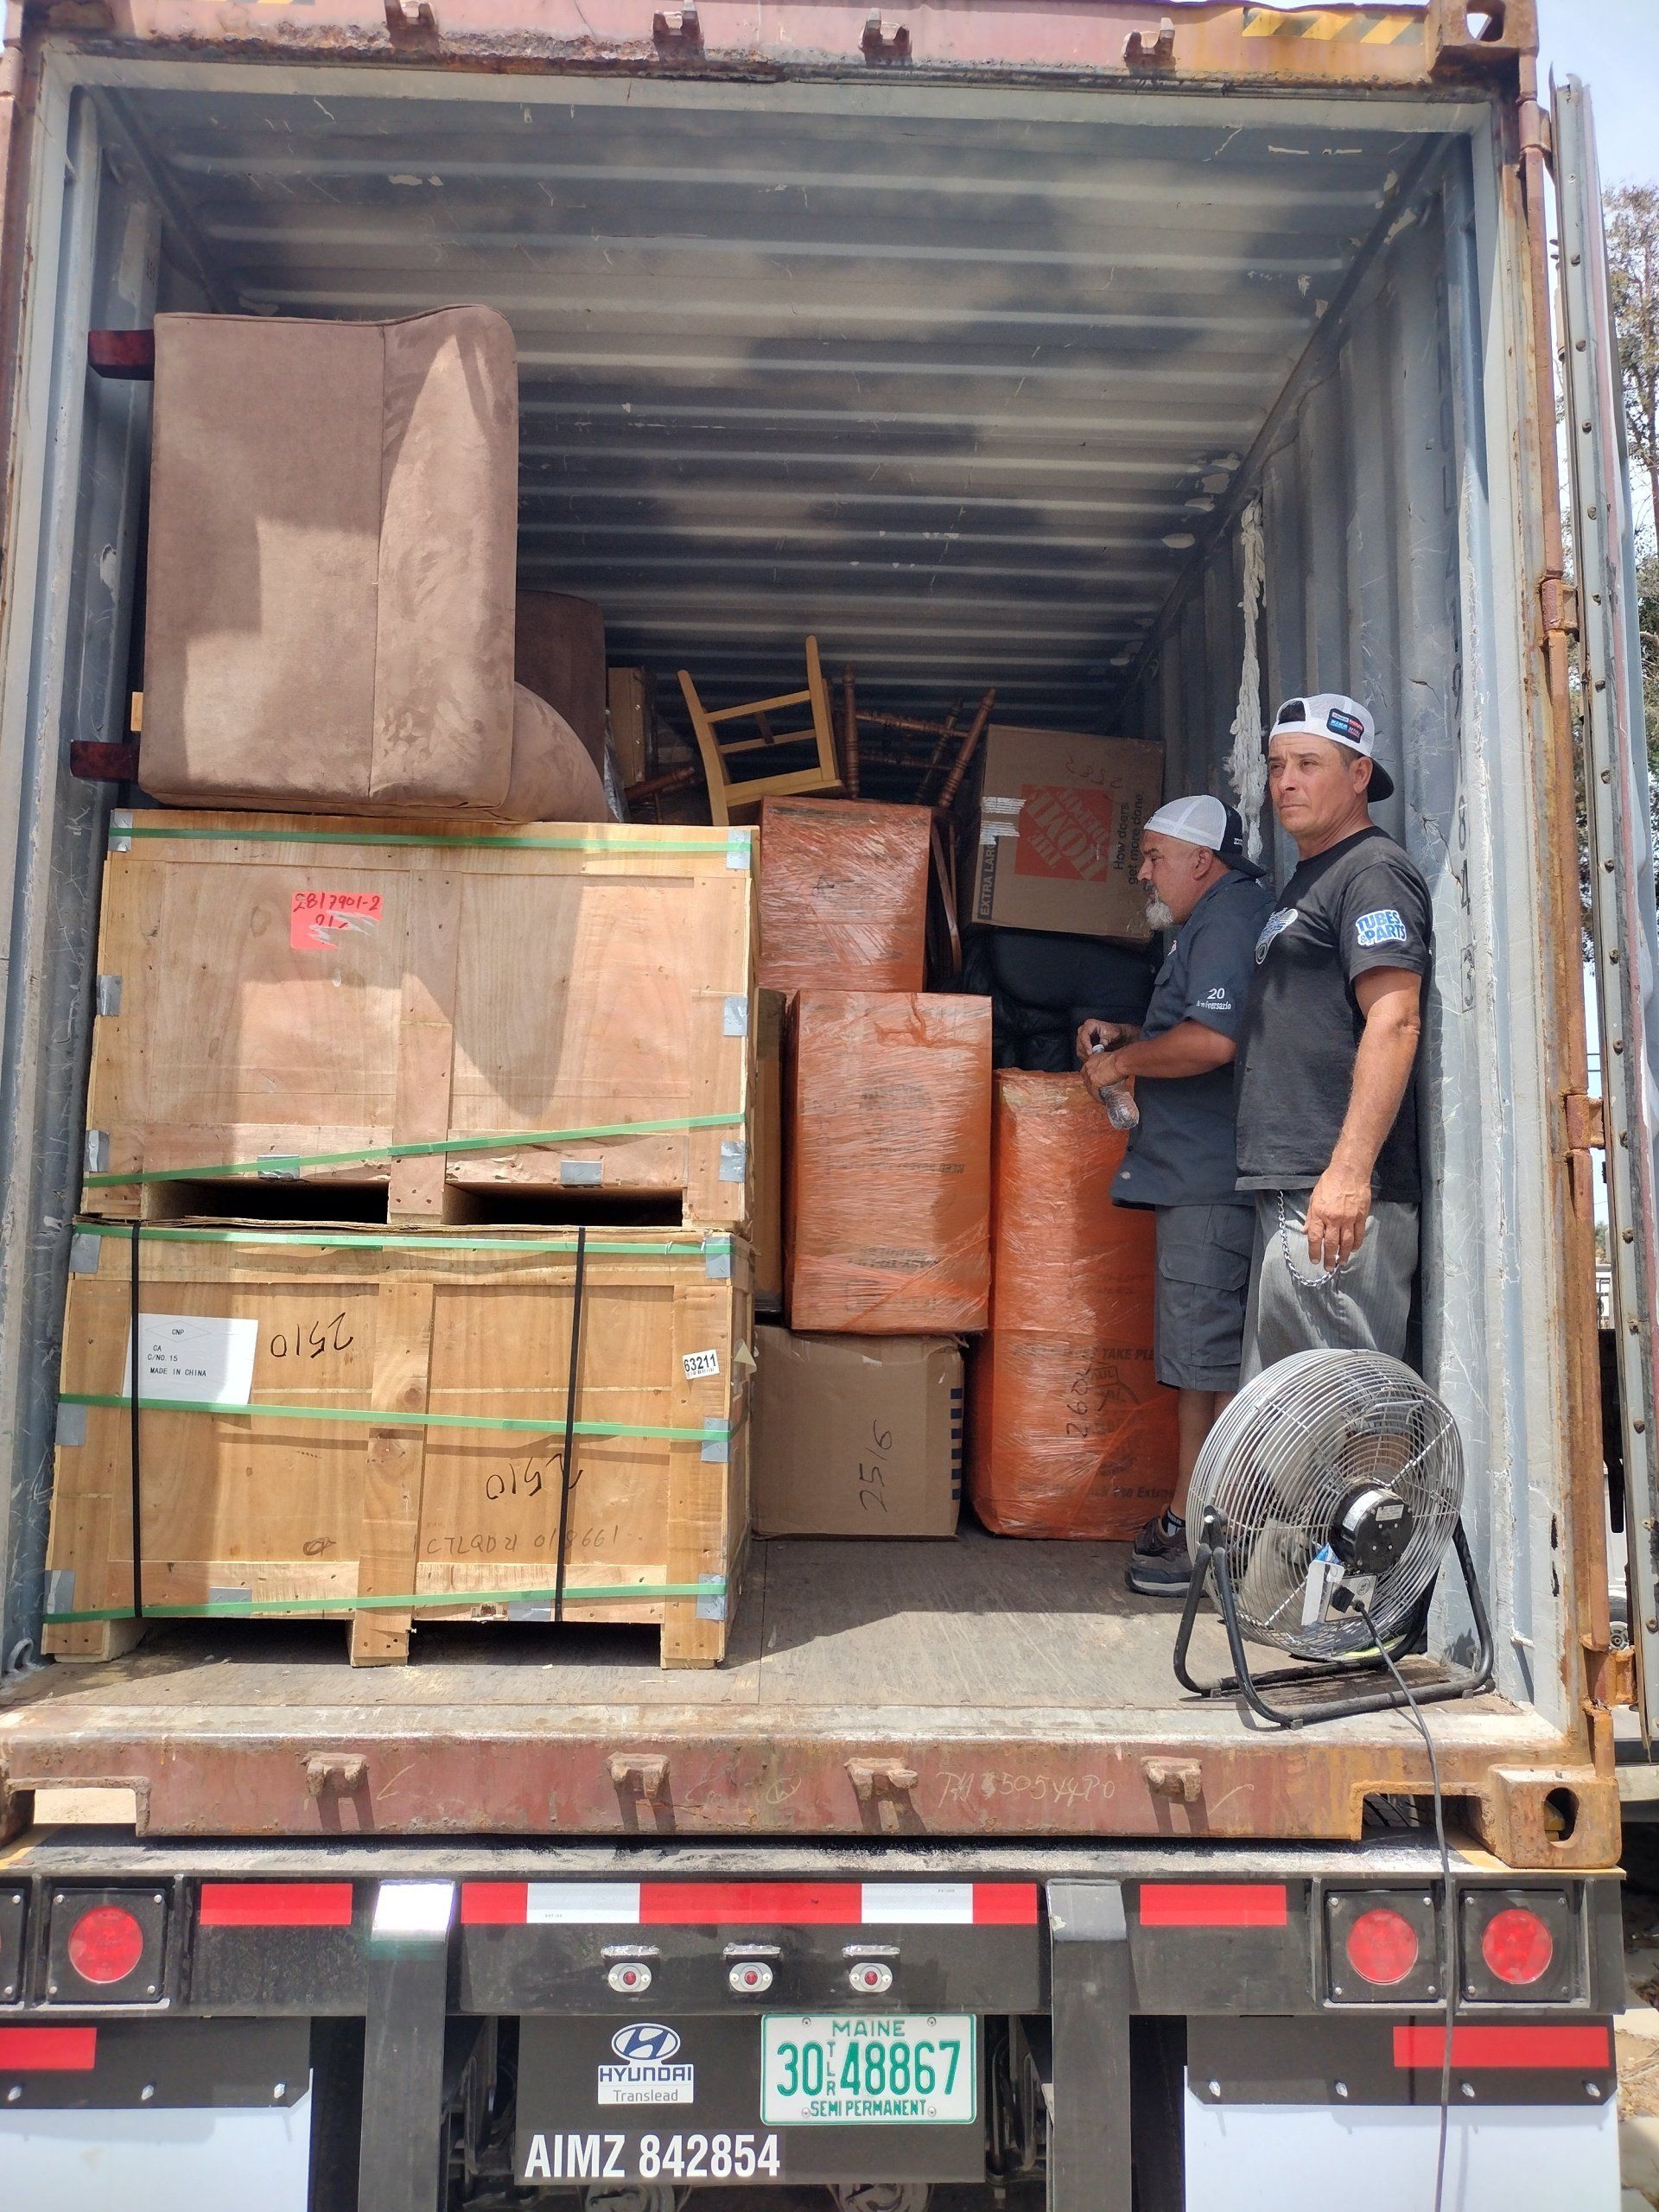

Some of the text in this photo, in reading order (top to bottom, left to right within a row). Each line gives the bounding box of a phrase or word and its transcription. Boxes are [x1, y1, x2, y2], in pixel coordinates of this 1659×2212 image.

[1112, 801, 1130, 871] How doers
[1130, 827, 1141, 861] more
[979, 875, 993, 916] EXTRA
[1356, 912, 1401, 932] TUBES
[1365, 925, 1406, 944] PARTS
[1207, 988, 1225, 1000] 20
[683, 1353, 716, 1372] 63211
[1103, 1348, 1132, 1360] TAKE
[149, 1367, 168, 1376] MADE
[859, 1419, 893, 1513] 2516
[832, 2020, 906, 2037] MAINE
[600, 2066, 691, 2082] HYUNDAI
[840, 2040, 961, 2096] 48867
[613, 2089, 678, 2102] Translead
[810, 2099, 927, 2117] SEMI PERMANENT
[524, 2133, 780, 2178] AIMZ 842854
